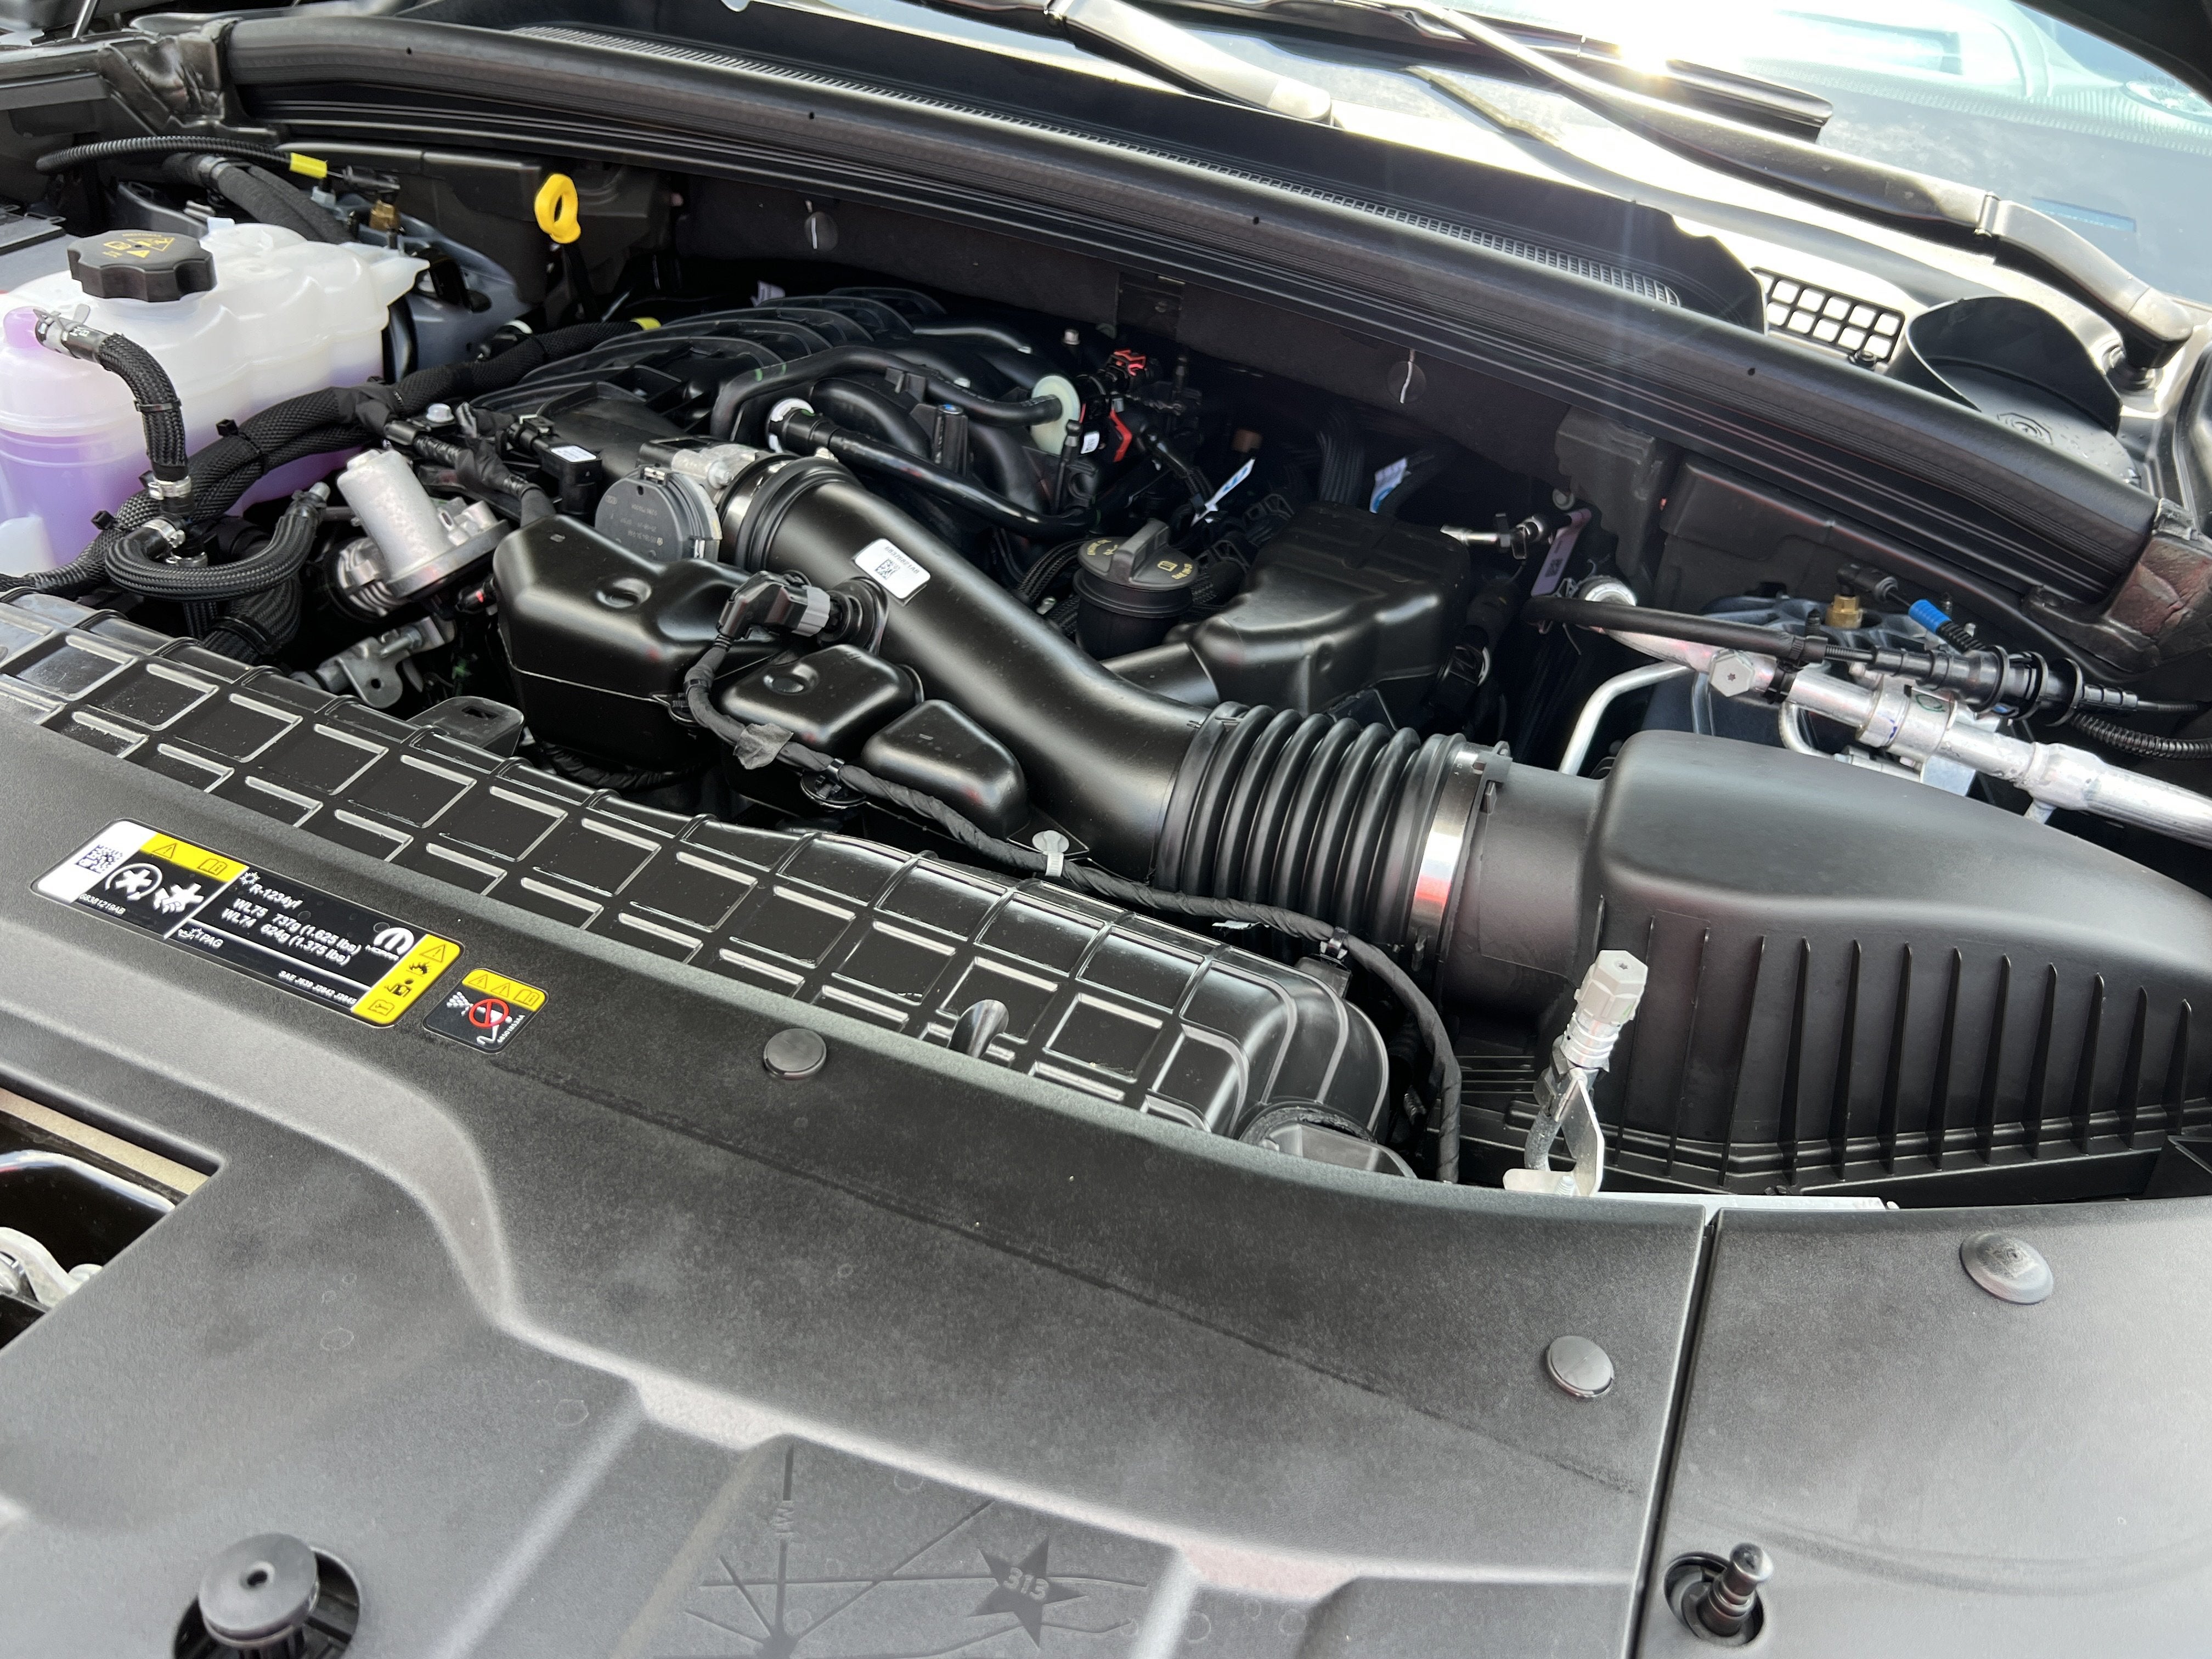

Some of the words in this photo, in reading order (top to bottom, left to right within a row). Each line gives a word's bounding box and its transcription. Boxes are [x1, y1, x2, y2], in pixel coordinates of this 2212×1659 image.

[249, 883, 303, 910] R-1234yf
[199, 933, 224, 949] PAG
[221, 907, 257, 929] WL74
[260, 923, 291, 944] 624g
[288, 934, 329, 957] (1.375
[325, 948, 351, 967] lbs)
[233, 898, 269, 919] WL75
[272, 912, 302, 933] 737g
[300, 924, 340, 946] (1.625
[336, 938, 362, 957] lbs)
[278, 969, 297, 983] SAE
[1002, 1566, 1049, 1600] 313
